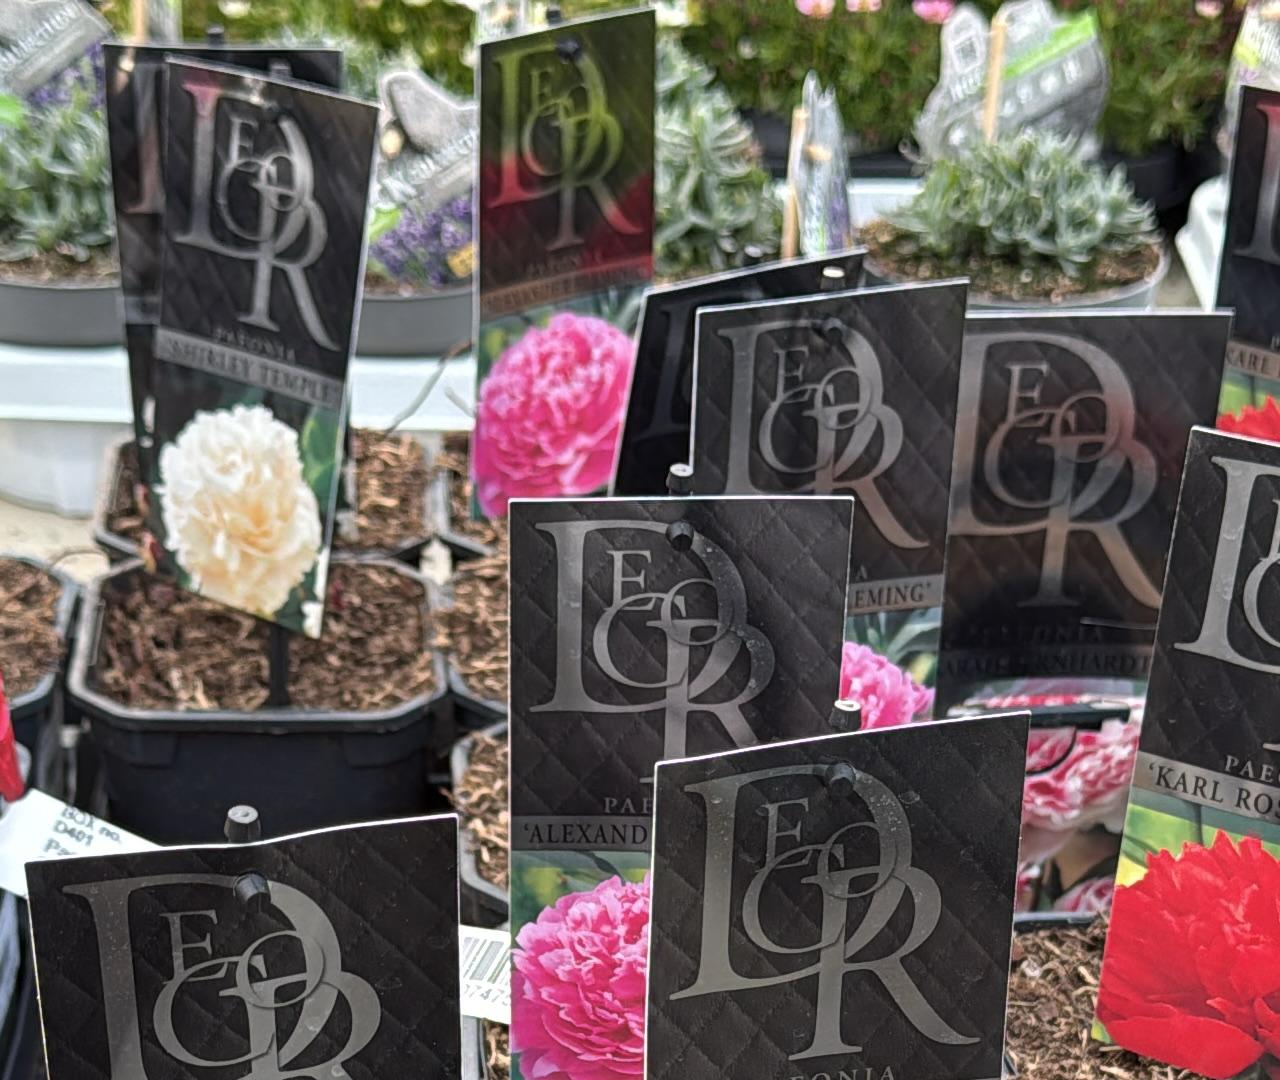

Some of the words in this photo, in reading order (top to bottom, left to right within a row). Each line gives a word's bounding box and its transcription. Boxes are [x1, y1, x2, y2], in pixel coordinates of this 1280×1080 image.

[854, 581, 932, 610] EMING'
[1149, 762, 1224, 804] 'KARL
[53, 818, 95, 848] D401
[524, 822, 649, 845] 'ALEXAND
